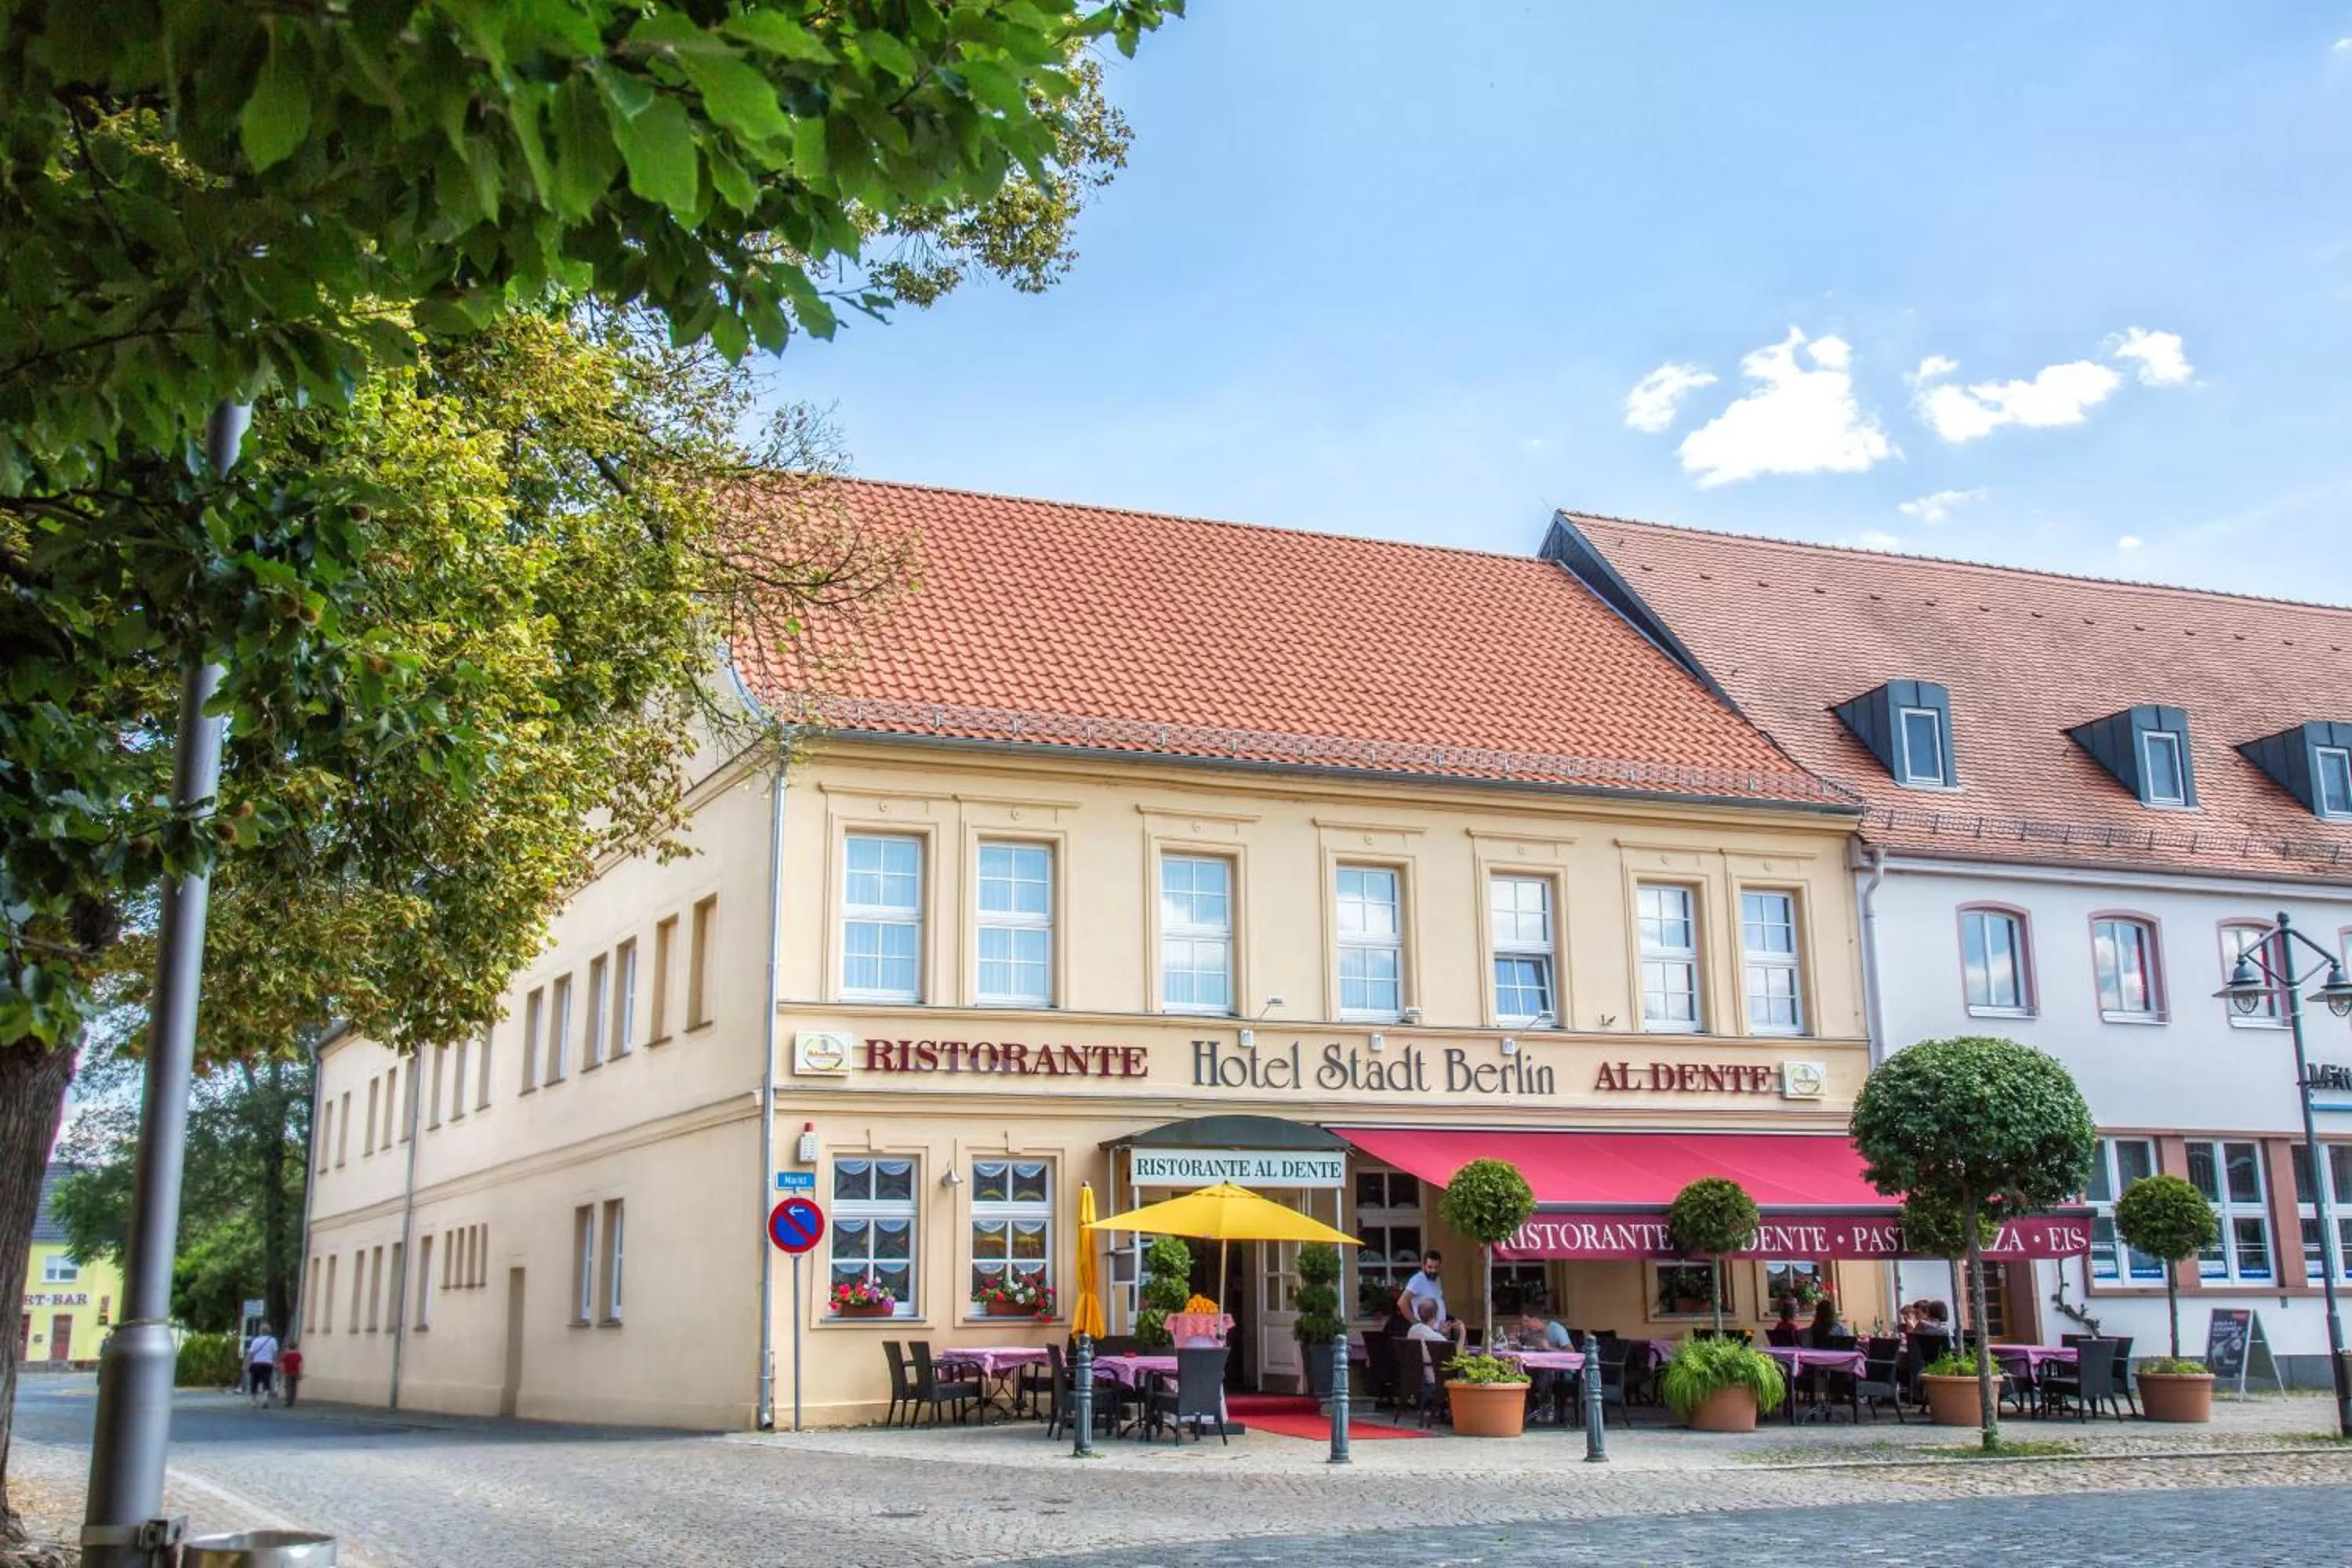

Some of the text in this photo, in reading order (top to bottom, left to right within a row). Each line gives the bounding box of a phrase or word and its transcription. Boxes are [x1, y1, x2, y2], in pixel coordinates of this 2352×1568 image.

[865, 1038, 1149, 1078] RISTORANTE
[1191, 1040, 1555, 1094] Hotel Stadt Berlin
[1594, 1061, 1773, 1093] AL DENTE
[1137, 1158, 1341, 1178] RISTORANTE AL DENTE
[2047, 1226, 2087, 1252] EIS
